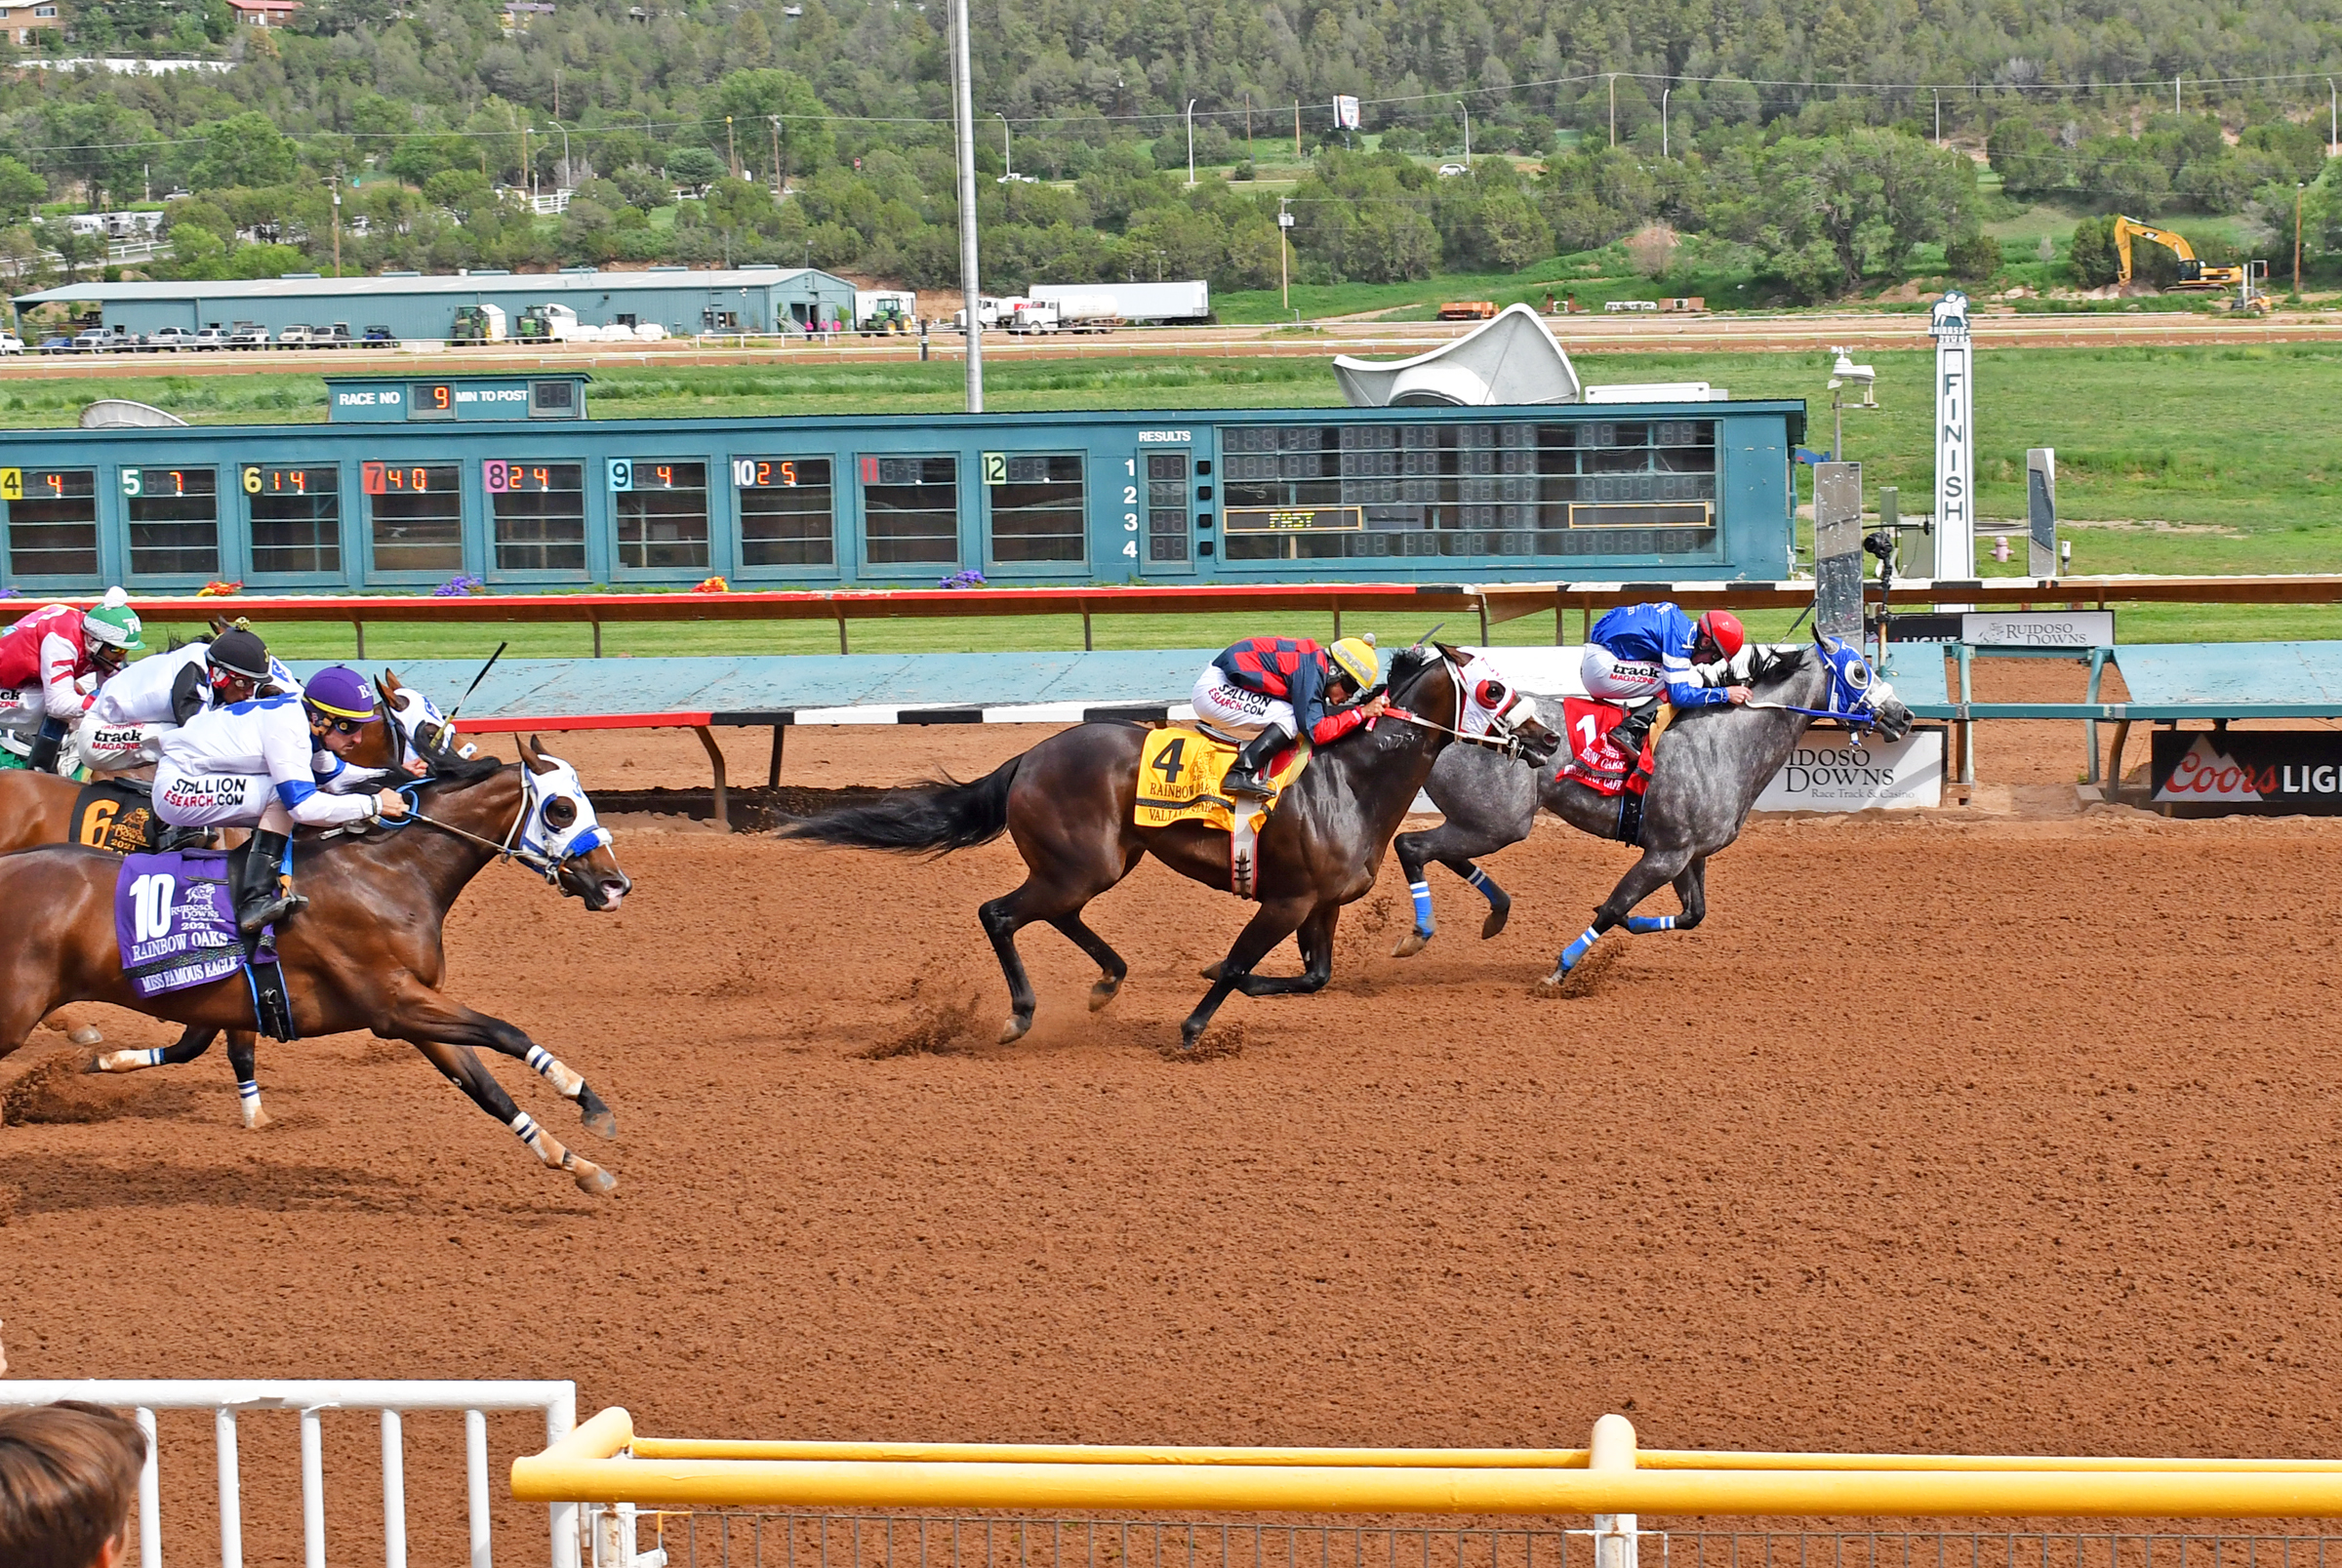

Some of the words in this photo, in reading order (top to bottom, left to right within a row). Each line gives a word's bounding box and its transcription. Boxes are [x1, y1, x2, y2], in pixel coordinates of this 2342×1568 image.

[340, 392, 376, 405] RACE
[380, 391, 400, 405] NO
[433, 386, 450, 410] 9
[456, 391, 477, 402] MIN
[481, 391, 496, 401] TO
[497, 390, 528, 401] POST
[1138, 430, 1191, 442] RESULTS
[1945, 373, 1962, 521] FINISH
[243, 466, 262, 494] 6
[365, 465, 382, 490] 7
[489, 461, 507, 489] 8
[612, 462, 628, 487] 9
[733, 460, 755, 487] 10
[861, 458, 878, 483] 11
[983, 456, 1005, 482] 12
[1124, 459, 1136, 476] 1
[4, 471, 20, 496] 4
[122, 469, 141, 495] 5
[1123, 486, 1138, 504] 2
[1124, 513, 1139, 532] 3
[1122, 540, 1138, 559] 4
[2005, 623, 2074, 639] RUIDOSO
[1609, 673, 1656, 685] MAGAZINE
[1613, 663, 1661, 678] track
[94, 729, 142, 742] track
[1575, 713, 1597, 748] 1
[92, 742, 141, 750] MAGAZINE
[1789, 748, 1871, 767] IDOSO
[1151, 738, 1186, 784] 4
[2165, 751, 2280, 793] Coors
[2282, 764, 2342, 793] LIG
[1784, 766, 1895, 793] DOWNS
[1811, 788, 1836, 798] Race
[1837, 788, 1865, 798] Track
[1867, 788, 1878, 798] &
[1879, 788, 1915, 799] Casino
[80, 798, 120, 849] 6
[129, 873, 176, 944] 10
[181, 921, 213, 931] 2021
[132, 933, 186, 961] RAINBOW
[191, 931, 228, 946] OAKS
[141, 976, 165, 992] MISS
[164, 964, 204, 987] FAMOUS
[204, 956, 238, 978] EAGLE
